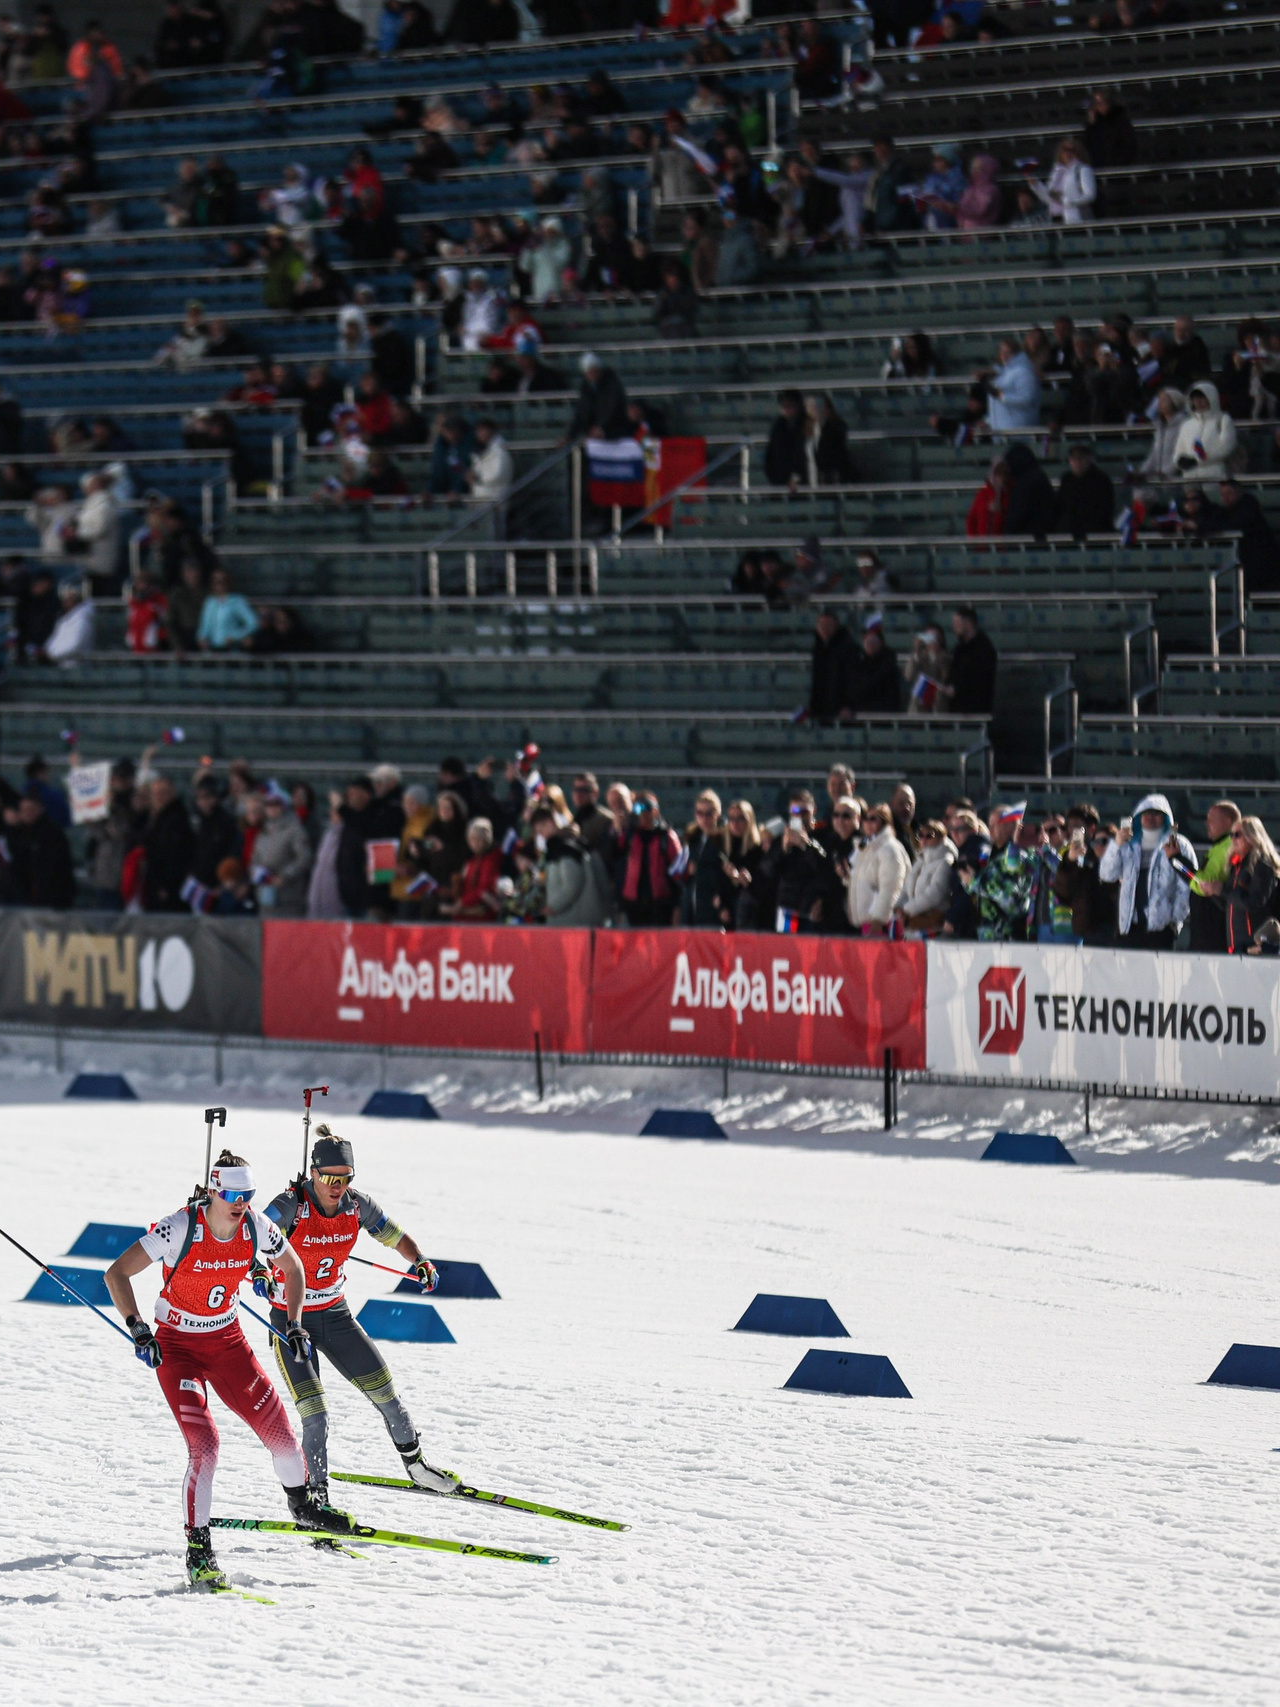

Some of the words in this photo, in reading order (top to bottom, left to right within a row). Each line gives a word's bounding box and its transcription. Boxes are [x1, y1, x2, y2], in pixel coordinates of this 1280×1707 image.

[338, 946, 434, 1013] Альфа
[439, 948, 514, 1003] Банк
[671, 952, 767, 1024] Альфа
[772, 959, 844, 1017] Банк
[1034, 994, 1267, 1046] ТЕХНОНИКОЛЬ
[303, 1234, 333, 1245] Альфа
[333, 1232, 354, 1243] Банк
[193, 1259, 226, 1271] Альфа
[227, 1258, 250, 1269] Банк
[316, 1256, 335, 1280] 2
[207, 1284, 227, 1309] 6
[552, 1510, 609, 1527] FISCHER
[480, 1547, 545, 1564] FISCHER
